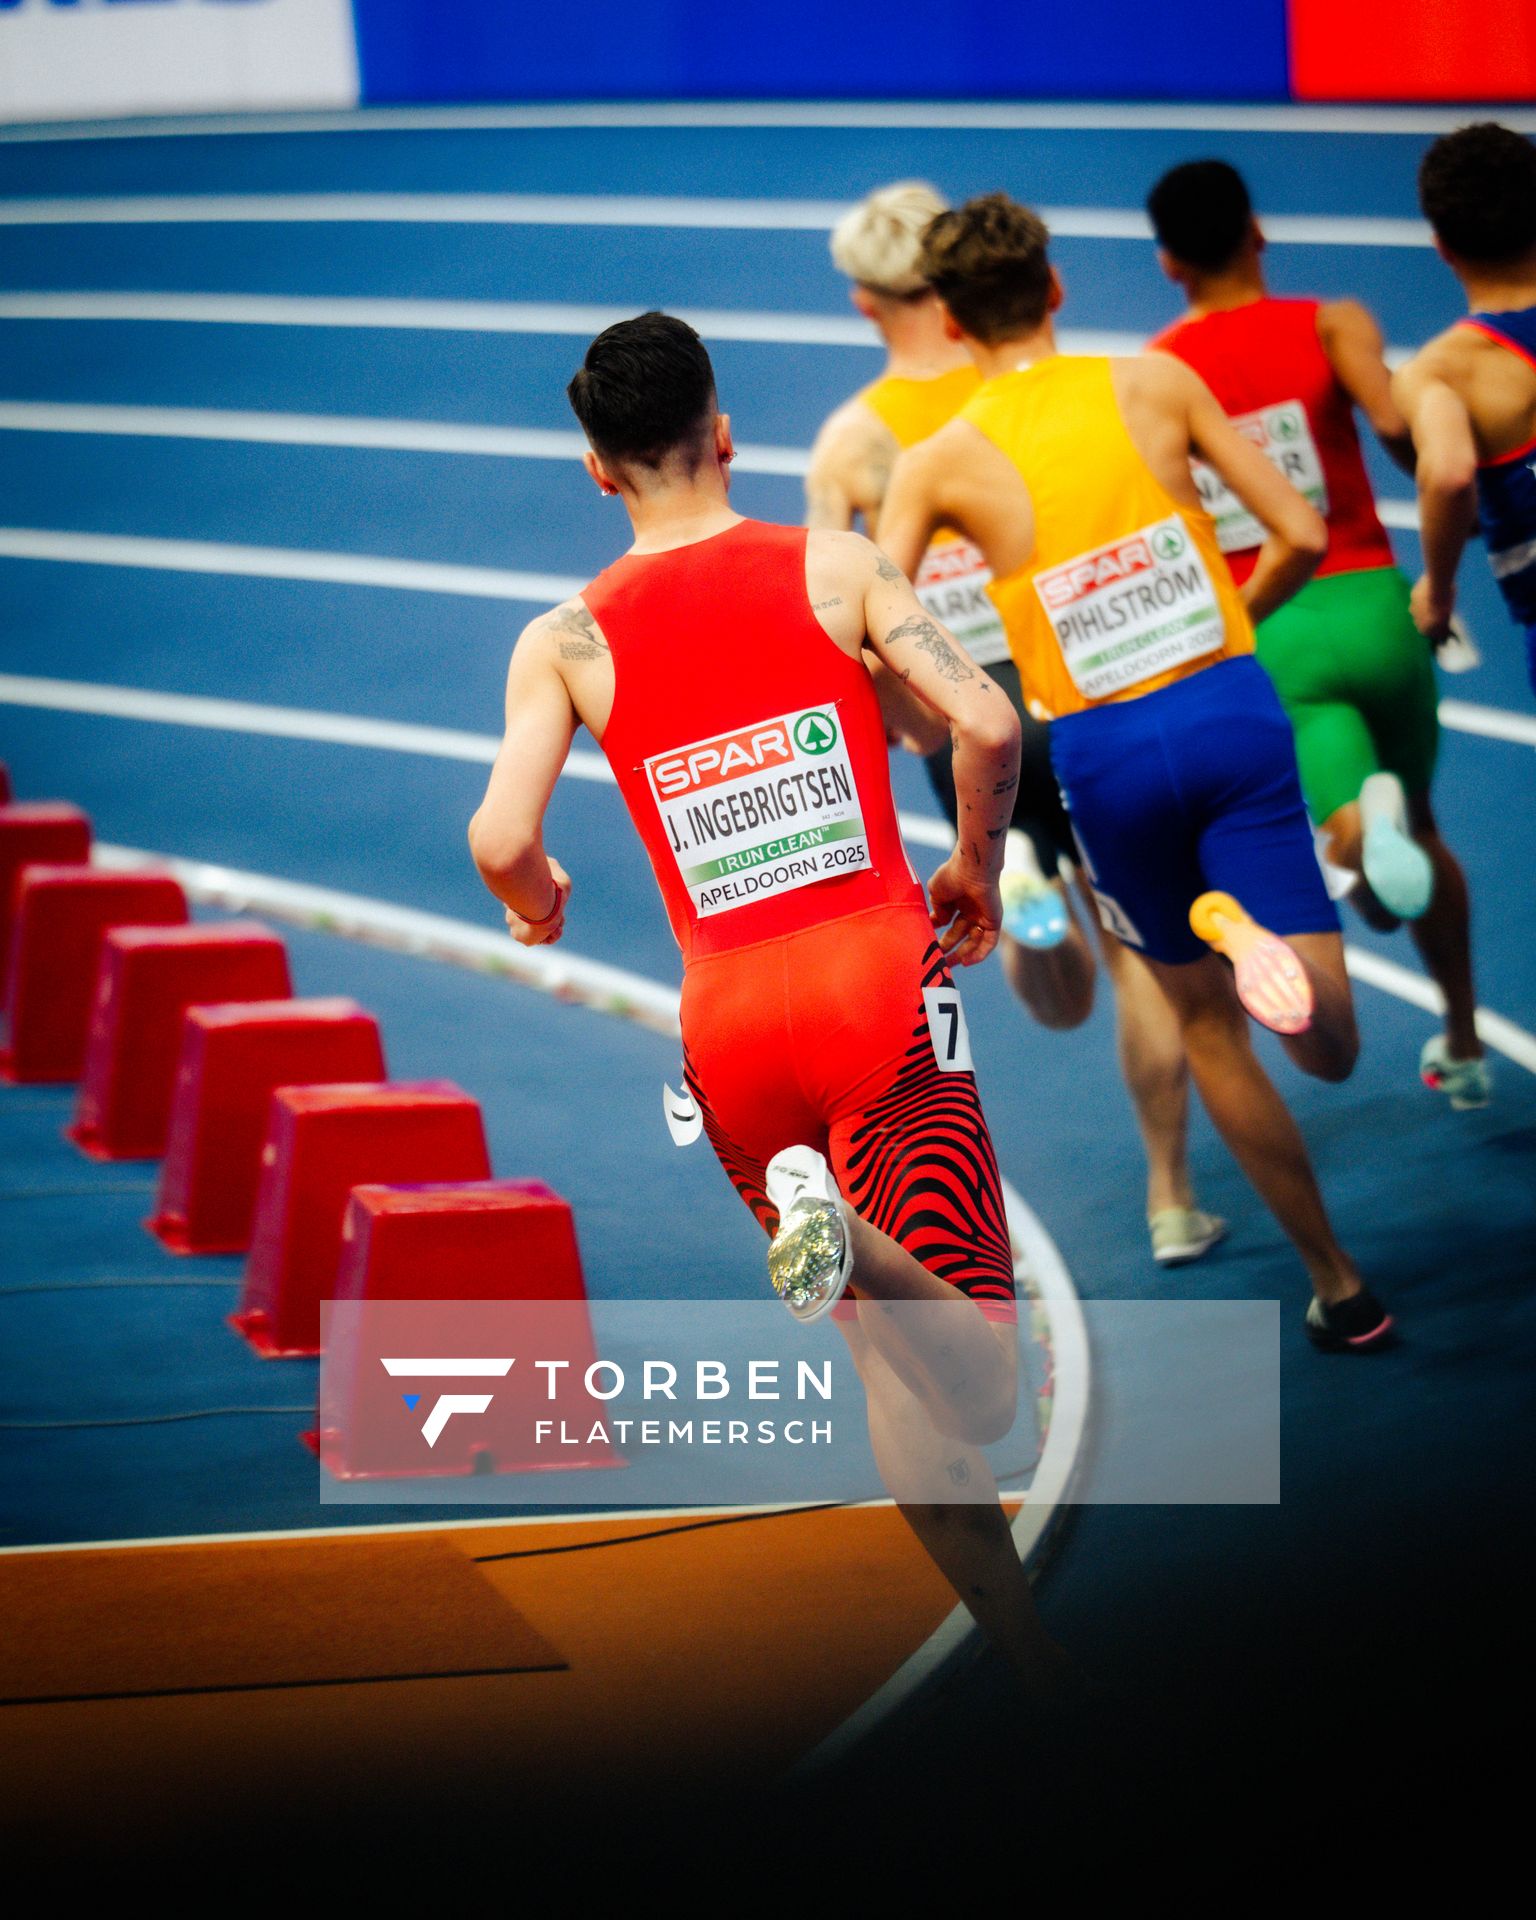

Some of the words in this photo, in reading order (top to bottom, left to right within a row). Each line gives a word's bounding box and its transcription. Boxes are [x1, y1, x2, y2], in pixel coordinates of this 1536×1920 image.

[1042, 543, 1150, 602] SPAR
[1056, 564, 1204, 648] PIHLSTRÖM
[1084, 643, 1184, 693] APELDOORN
[655, 727, 789, 795] SPAR
[667, 814, 689, 853] J.
[686, 763, 852, 846] INGEBRIGTSEN
[700, 856, 818, 909] APELDOORN
[823, 845, 866, 870] 2025
[717, 862, 724, 875] I
[727, 849, 765, 871] RUN
[938, 1003, 958, 1060] 7
